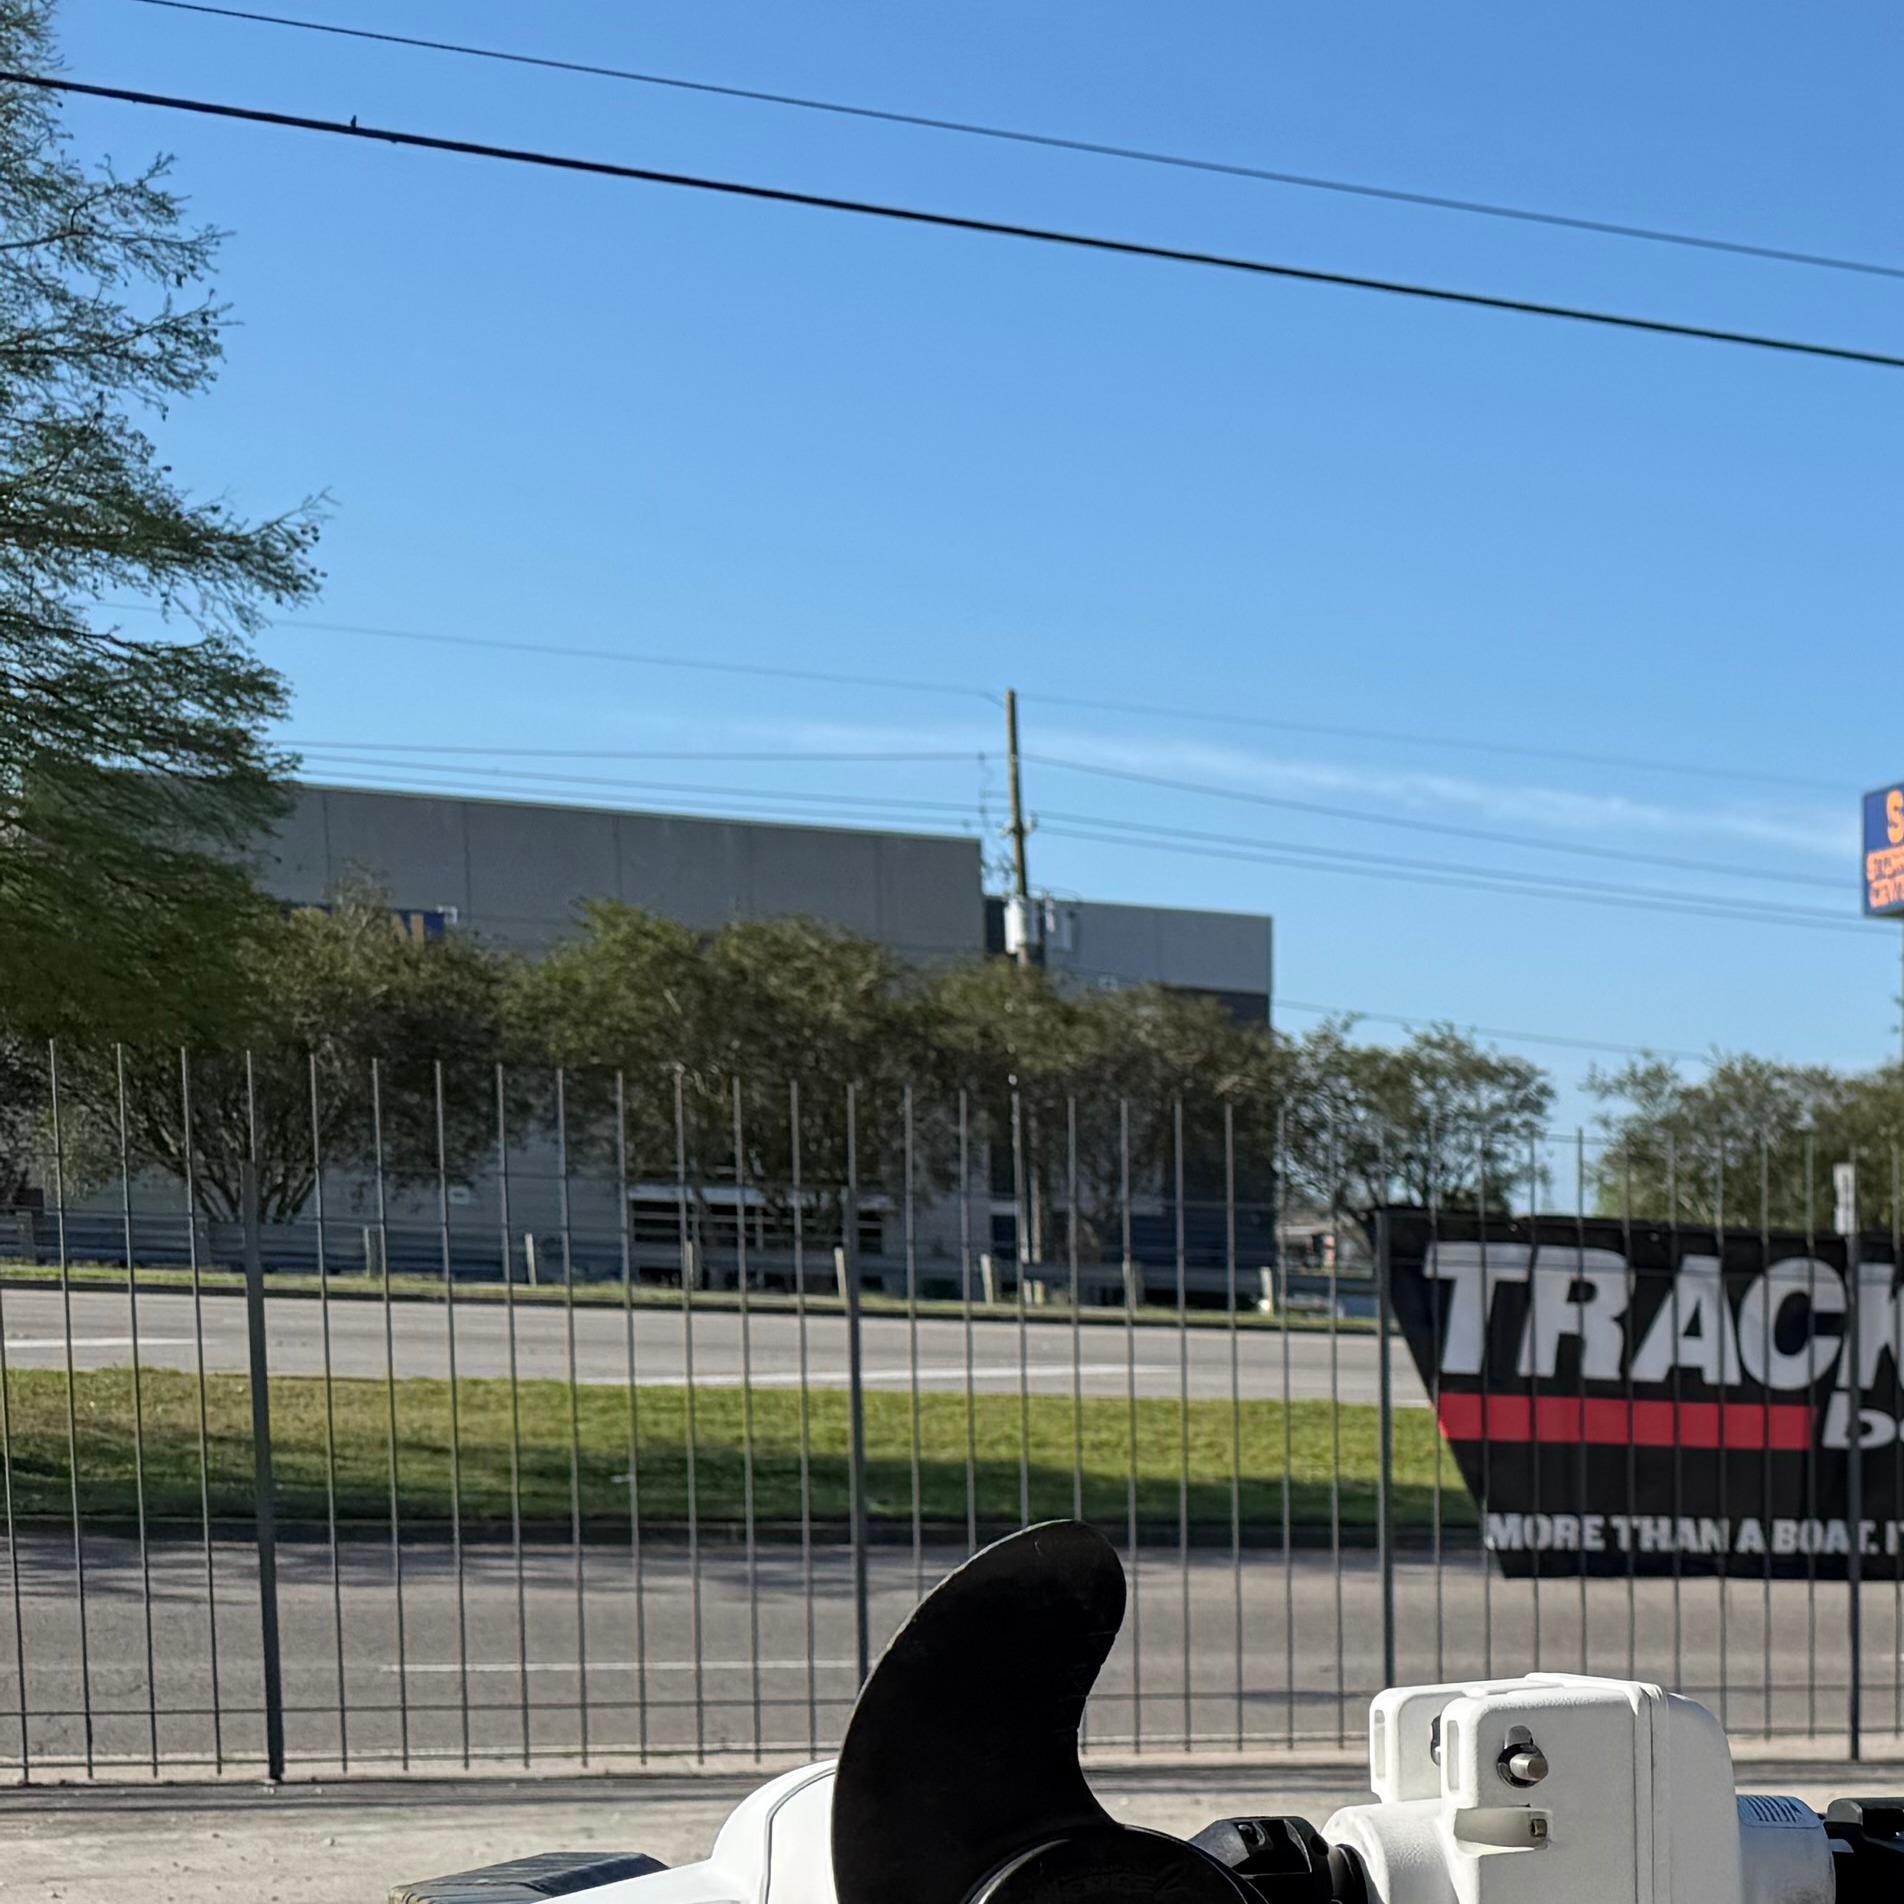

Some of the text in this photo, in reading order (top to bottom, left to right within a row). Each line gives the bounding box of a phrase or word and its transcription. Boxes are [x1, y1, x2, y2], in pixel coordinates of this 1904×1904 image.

[1486, 1512, 1605, 1551] MORE
[1611, 1514, 1730, 1554] THAN
[1735, 1517, 1767, 1554] A
